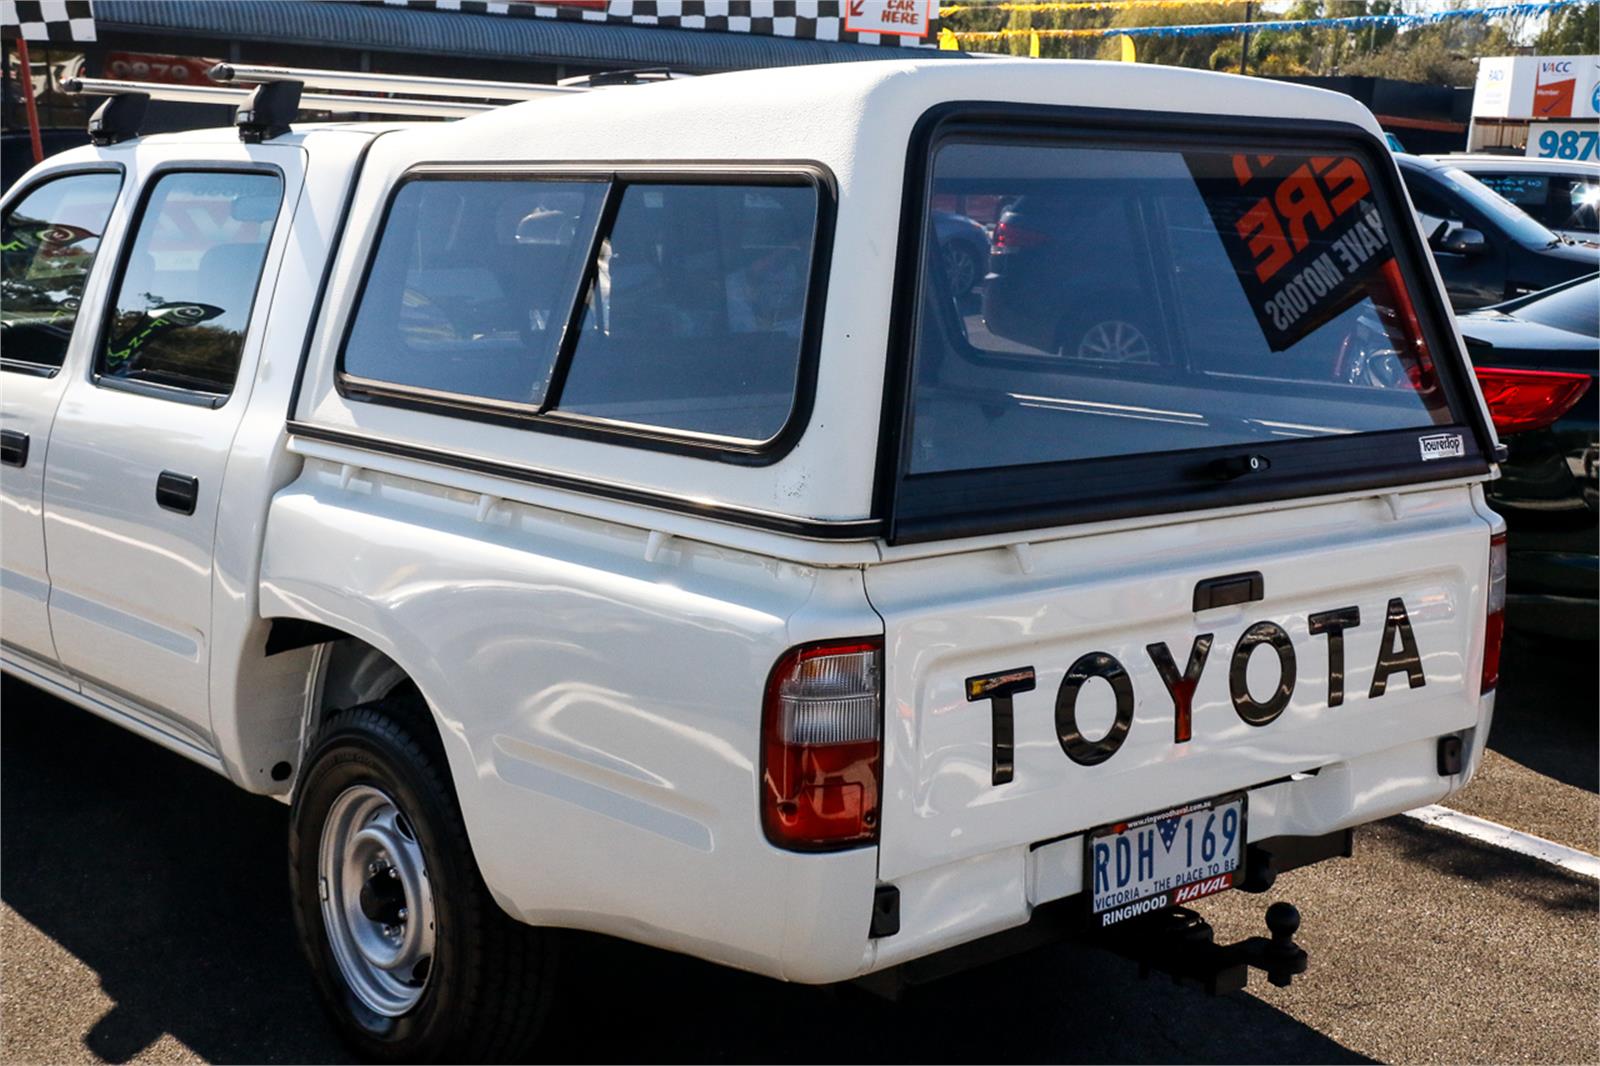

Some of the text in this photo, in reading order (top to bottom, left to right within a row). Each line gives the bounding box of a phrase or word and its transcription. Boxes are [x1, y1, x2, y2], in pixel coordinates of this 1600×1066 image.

[881, 10, 918, 24] HERE
[887, 0, 914, 11] CAR
[1542, 61, 1572, 73] VACC
[965, 597, 1426, 786] TOYOTA
[1095, 808, 1238, 895] RDH 169
[1095, 888, 1140, 911] VICTORIA
[1154, 879, 1171, 892] THE
[1176, 867, 1203, 886] PLACE
[1208, 862, 1220, 875] TO
[1225, 858, 1235, 871] BE
[1103, 876, 1230, 927] RINGWOOD HAVAL
